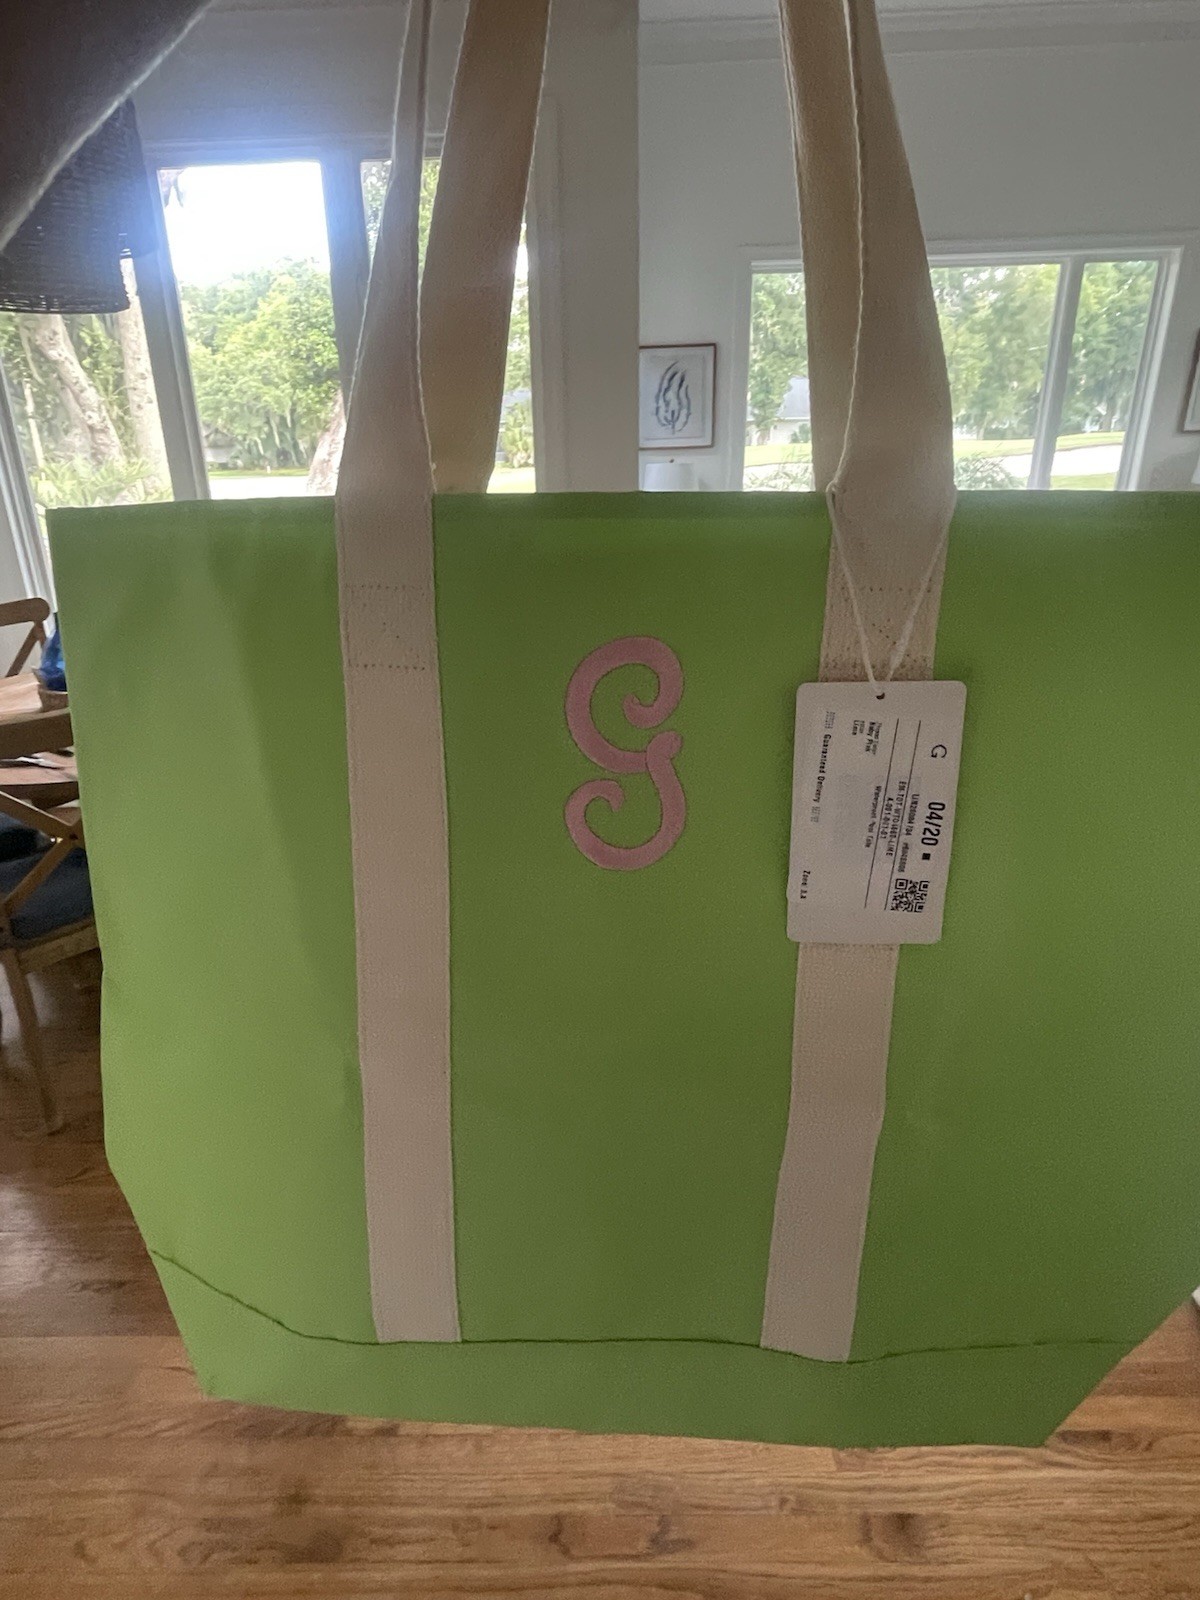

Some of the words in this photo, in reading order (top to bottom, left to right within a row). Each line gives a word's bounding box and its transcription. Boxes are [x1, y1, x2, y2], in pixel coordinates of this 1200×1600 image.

[819, 734, 832, 774] Guaranteed
[931, 744, 948, 758] G
[813, 776, 826, 803] Delivery
[920, 802, 946, 846] 04/20
